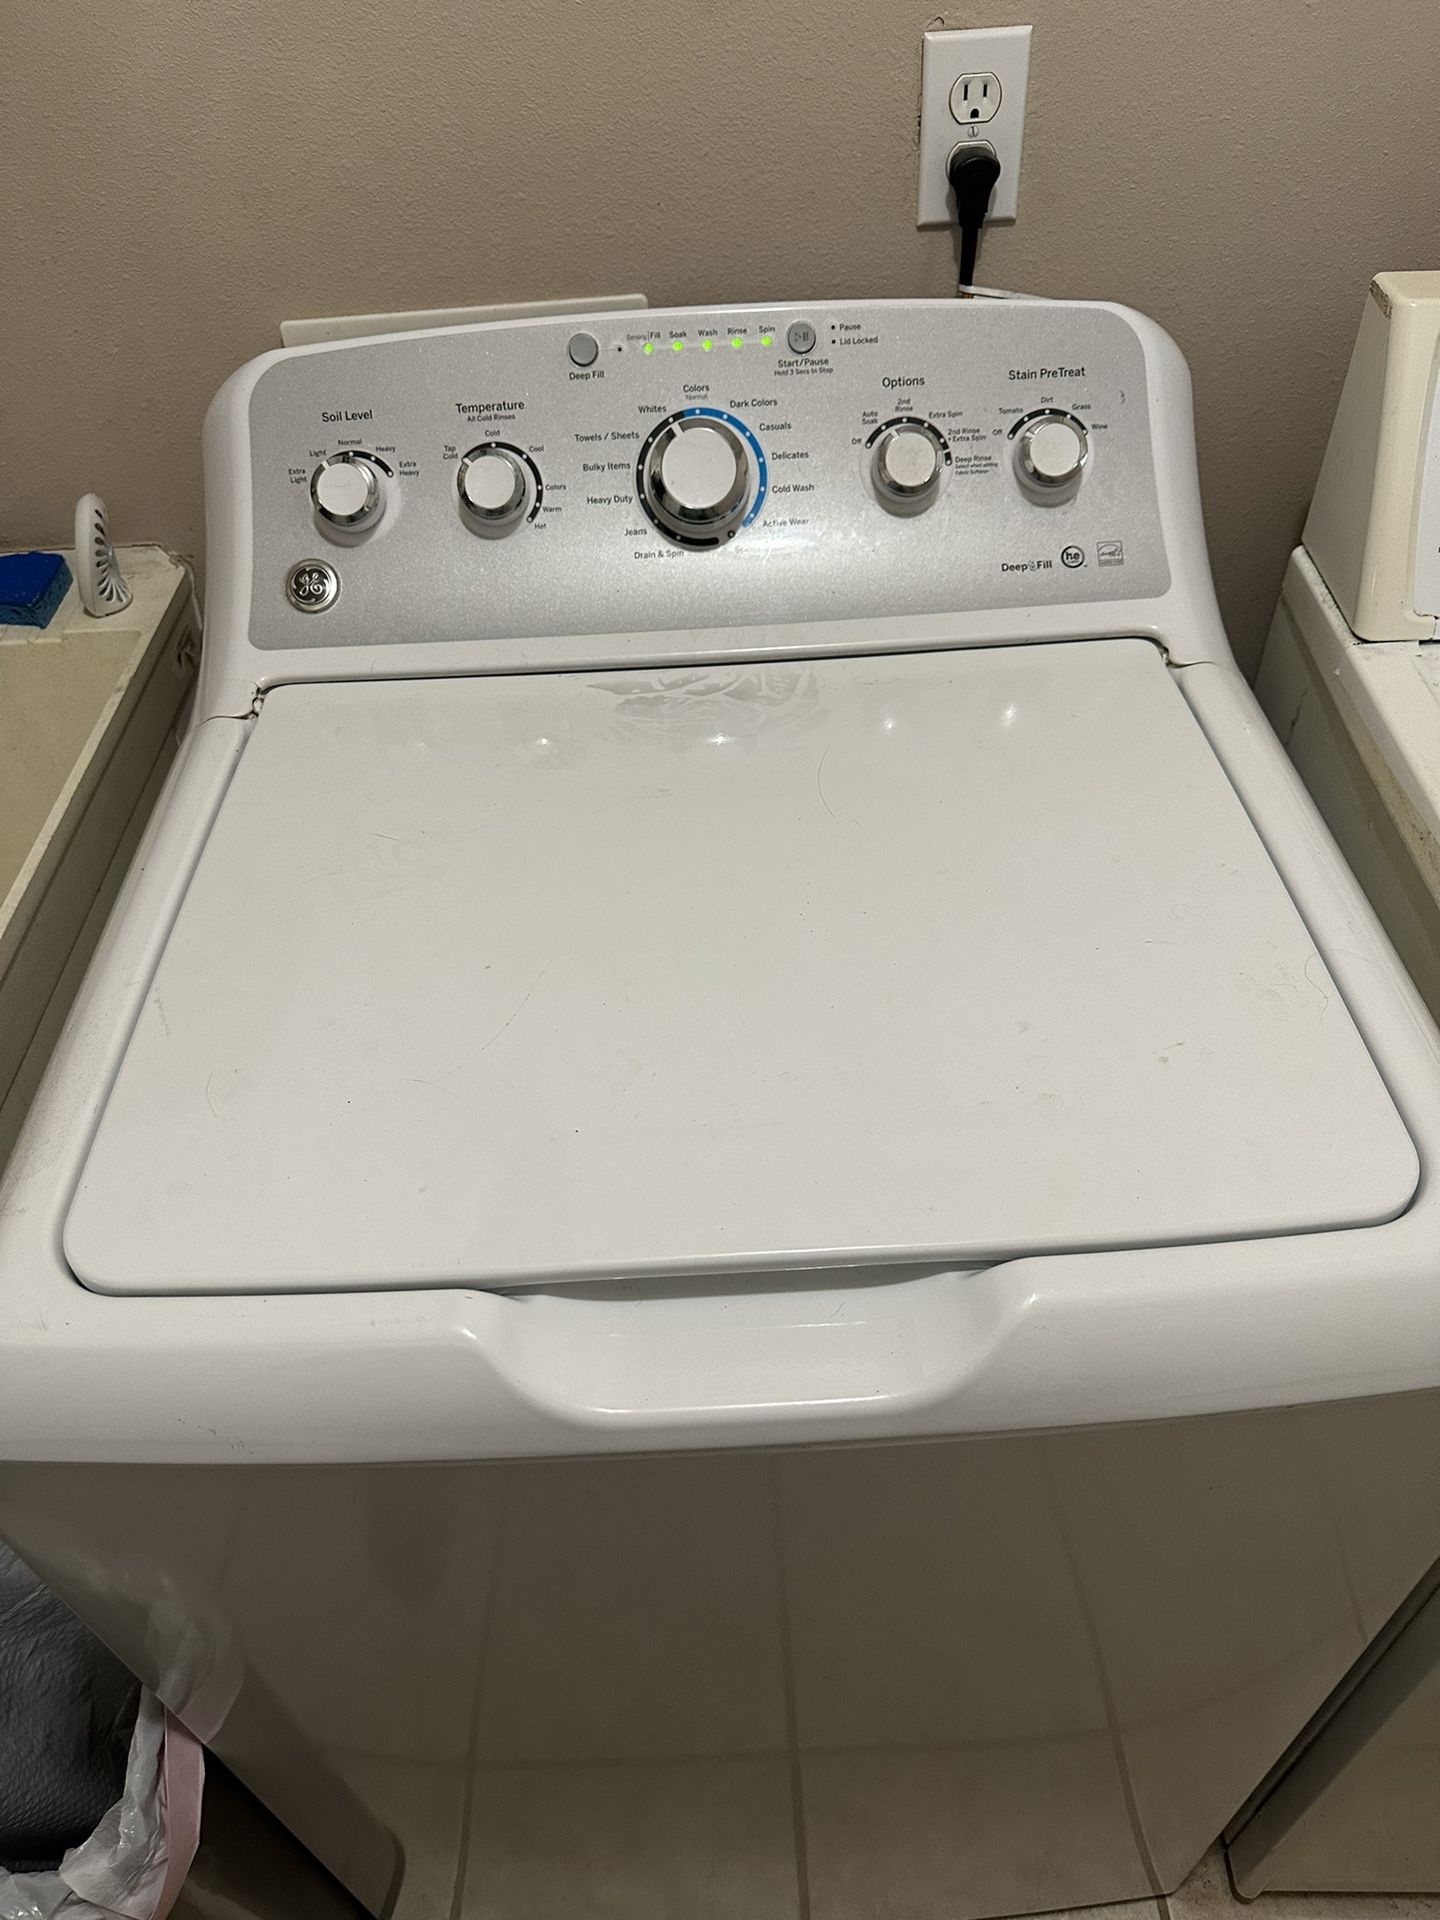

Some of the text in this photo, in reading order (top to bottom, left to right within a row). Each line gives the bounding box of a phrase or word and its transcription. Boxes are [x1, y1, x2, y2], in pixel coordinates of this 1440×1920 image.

[727, 327, 748, 335] Rinse
[758, 326, 776, 334] Spin
[839, 323, 861, 331] Pause
[650, 331, 661, 339] Fill
[669, 331, 687, 339] Soak
[698, 329, 718, 337] Wash
[839, 336, 879, 345] Lid Locked
[777, 358, 829, 367] Start/Pause
[569, 370, 605, 381] Deep Fill
[1008, 366, 1086, 380] Stain PreTreat
[882, 376, 925, 389] Options
[682, 384, 710, 392] Colors
[455, 401, 525, 414] Temperature
[729, 398, 778, 408] Dark Colors
[1071, 403, 1091, 411] Grass
[638, 405, 667, 413] Whites
[321, 409, 373, 422] Soil Level
[928, 411, 946, 419] Extra
[759, 422, 792, 431] Casuals
[484, 429, 501, 437] Cold
[574, 433, 602, 442] Towels
[611, 431, 640, 440] Sheets
[309, 449, 327, 457] Light
[771, 451, 809, 460] Delicates
[582, 462, 631, 472] Bulky Items
[290, 476, 307, 484] Light
[771, 483, 815, 494] Cold Wash
[586, 495, 633, 505] Heavy Duty
[624, 527, 648, 537] Jeans
[634, 551, 656, 559] Drain
[666, 549, 685, 558] Spin
[1001, 560, 1053, 572] Deep Fill
